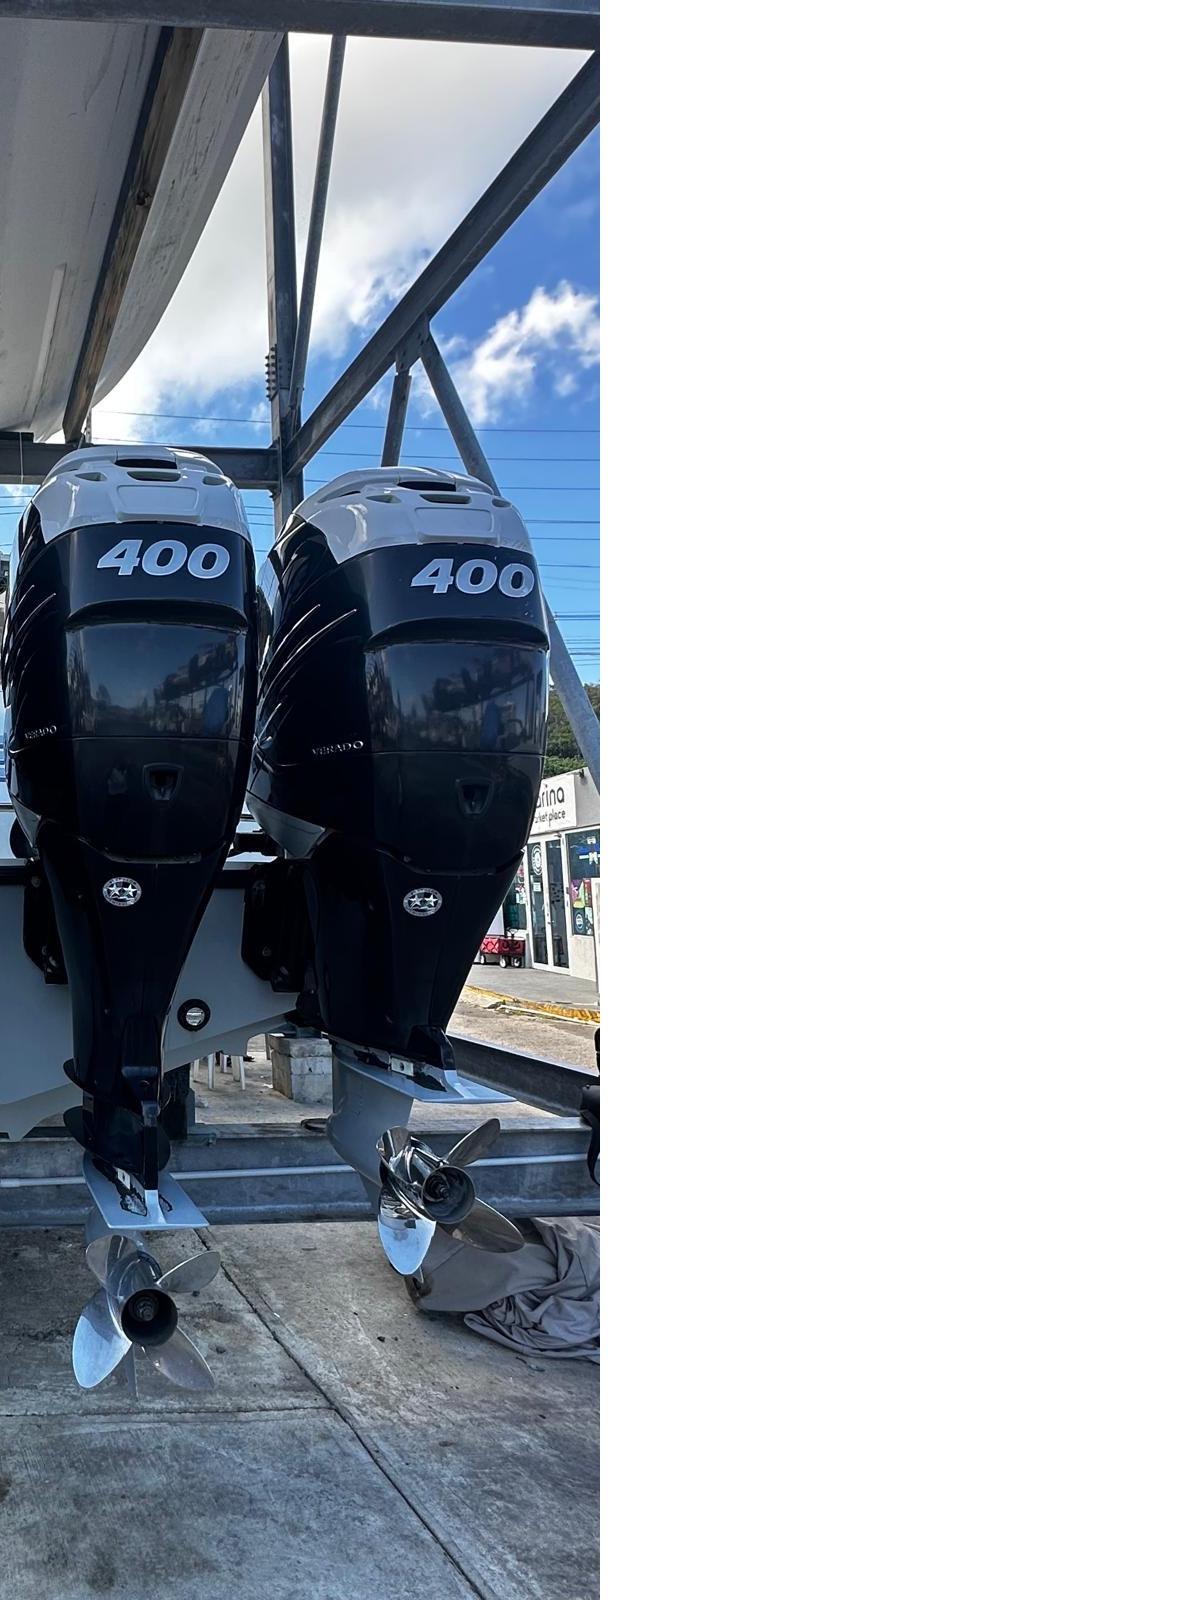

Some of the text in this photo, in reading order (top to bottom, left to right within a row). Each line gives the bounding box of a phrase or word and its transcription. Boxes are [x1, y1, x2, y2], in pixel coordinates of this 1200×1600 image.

[96, 539, 230, 579] 400
[410, 558, 535, 598] 400
[548, 809, 566, 827] place
